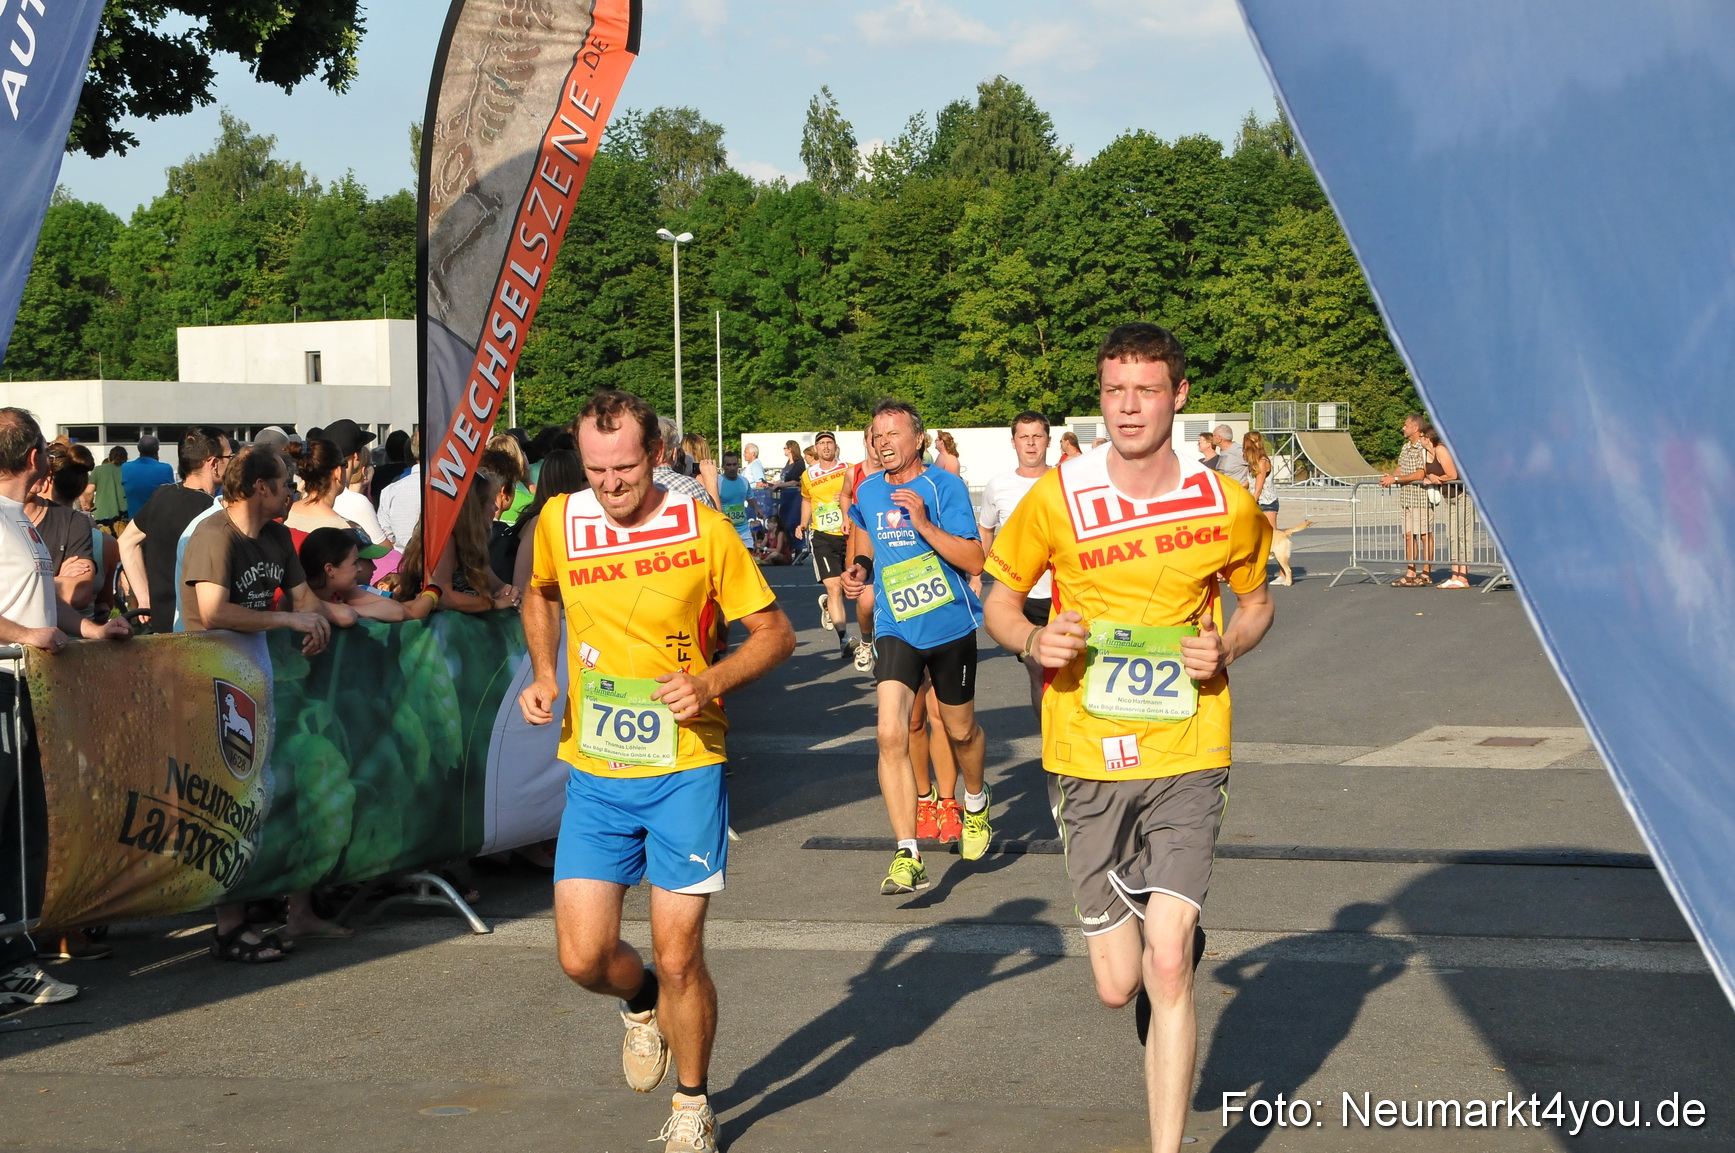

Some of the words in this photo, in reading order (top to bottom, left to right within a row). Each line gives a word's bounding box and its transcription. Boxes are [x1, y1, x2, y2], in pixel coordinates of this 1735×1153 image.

[811, 477, 829, 487] MAX
[819, 511, 840, 526] 753
[876, 512, 884, 530] I
[877, 528, 915, 540] camping
[1078, 539, 1147, 571] MAX
[1155, 525, 1228, 554] BÖGL
[569, 563, 627, 586] MAX
[635, 550, 705, 576] BÖGL
[891, 577, 947, 612] 5036
[1106, 638, 1146, 648] firmenlauf
[1102, 656, 1181, 697] 792
[594, 686, 627, 699] firmenlauf
[1133, 697, 1162, 705] Hartmann
[1115, 705, 1145, 713] Bauservice
[593, 703, 660, 743] 769
[604, 748, 629, 757] Bauservice
[605, 741, 625, 750] Thomas
[229, 750, 247, 772] 1628
[1079, 911, 1110, 925] hummel
